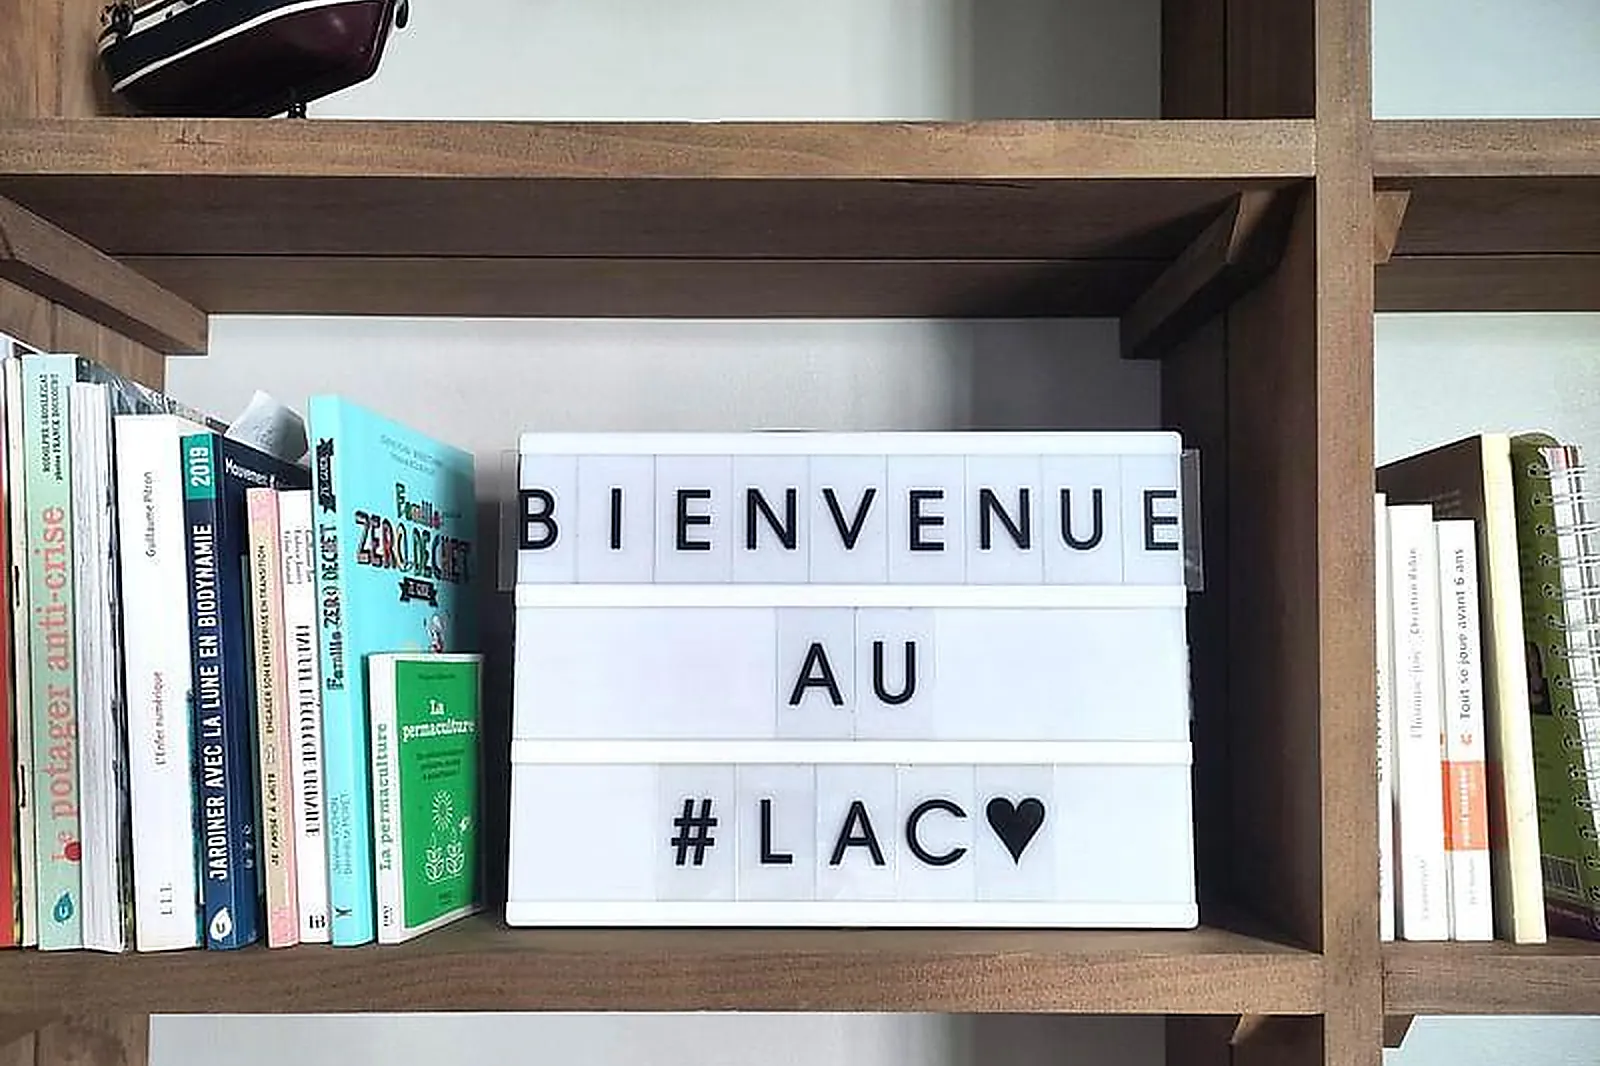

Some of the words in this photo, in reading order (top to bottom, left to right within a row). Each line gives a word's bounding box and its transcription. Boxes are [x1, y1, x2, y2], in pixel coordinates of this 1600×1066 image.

[143, 471, 154, 503] Pitron
[190, 446, 210, 487] 2019
[144, 504, 157, 558] Guillaume
[517, 487, 1180, 553] BIENVENUE
[193, 524, 216, 628] BIODYNAMIE
[1453, 549, 1465, 573] ans
[1453, 577, 1465, 586] 6
[35, 507, 69, 671] anti-crise
[323, 585, 340, 629] ZERO
[1454, 590, 1466, 630] avant
[198, 635, 217, 659] EN
[199, 665, 220, 708] LUNE
[788, 640, 918, 706] AU
[202, 715, 222, 738] LA
[1459, 689, 1471, 720] Tout
[41, 684, 79, 821] potager
[203, 744, 223, 788] AVEC
[376, 723, 394, 845] permaculture
[205, 796, 228, 880] JARDINER
[670, 797, 968, 867] #LAC
[379, 849, 392, 871] La
